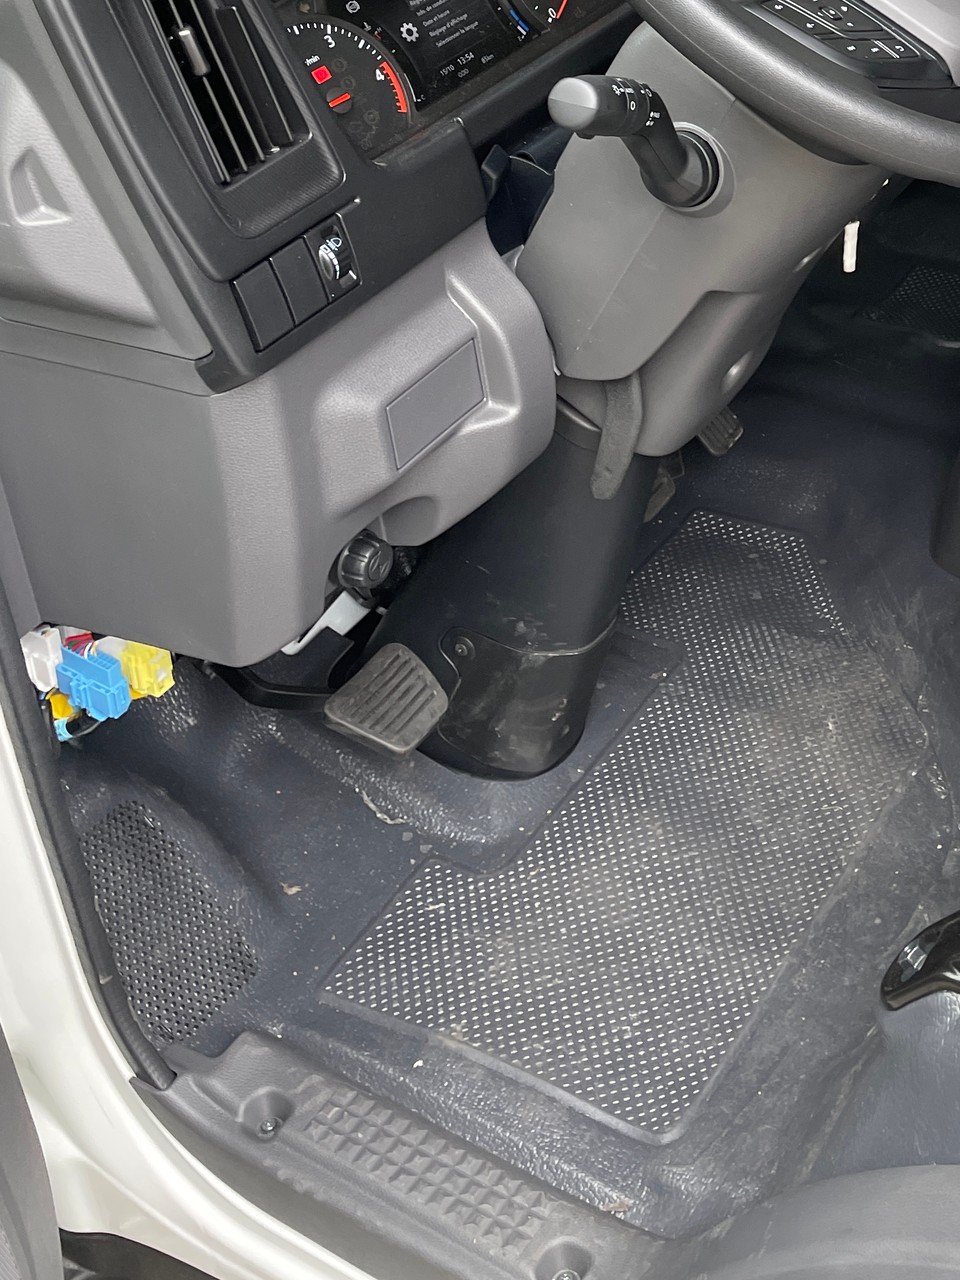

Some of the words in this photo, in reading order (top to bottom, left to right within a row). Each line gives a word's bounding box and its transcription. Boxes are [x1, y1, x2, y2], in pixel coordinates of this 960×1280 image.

[548, 7, 557, 19] 0
[323, 34, 336, 49] 3
[457, 52, 475, 65] 13:54
[375, 68, 385, 81] 4
[440, 65, 455, 76] 15/10
